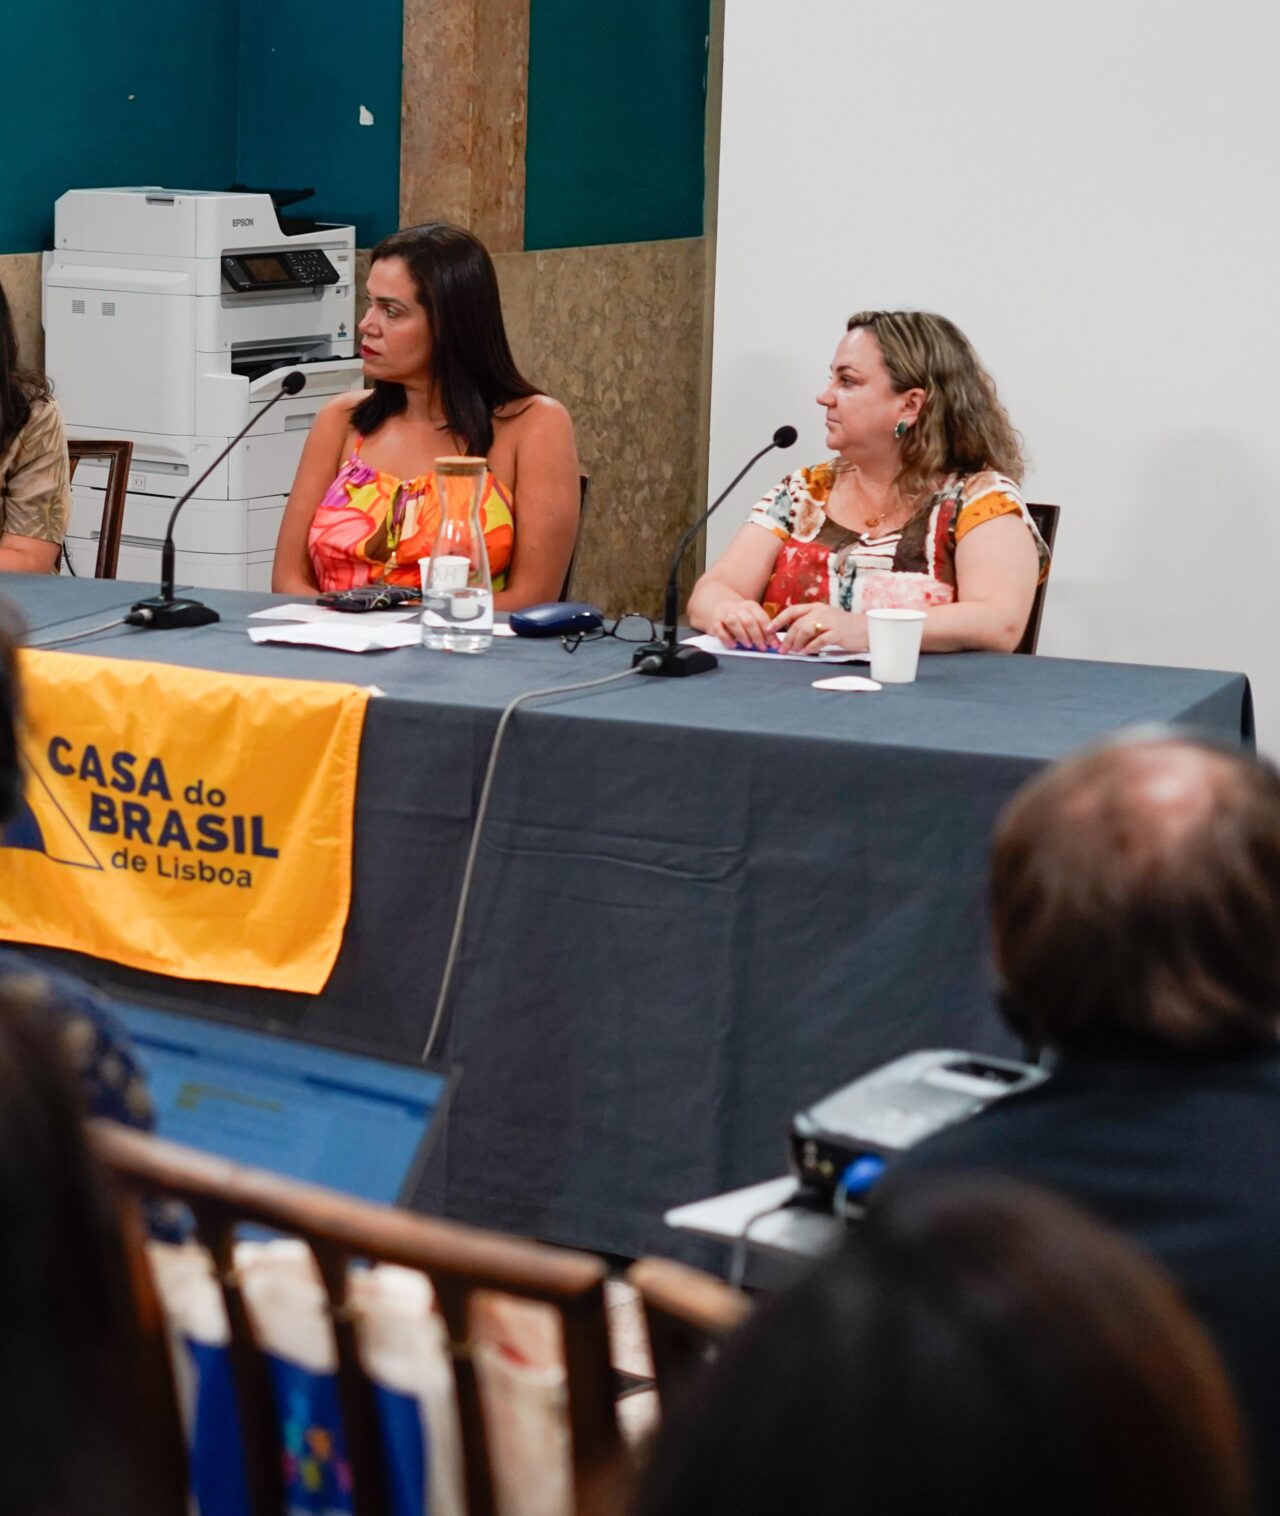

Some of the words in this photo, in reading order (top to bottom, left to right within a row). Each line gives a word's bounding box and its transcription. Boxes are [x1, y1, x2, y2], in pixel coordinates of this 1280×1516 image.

[232, 217, 254, 227] EPSON
[47, 736, 172, 800] CASA
[184, 779, 226, 807] do
[89, 791, 279, 859] BRASIL
[111, 848, 147, 872] de
[157, 854, 252, 888] Lisboa
